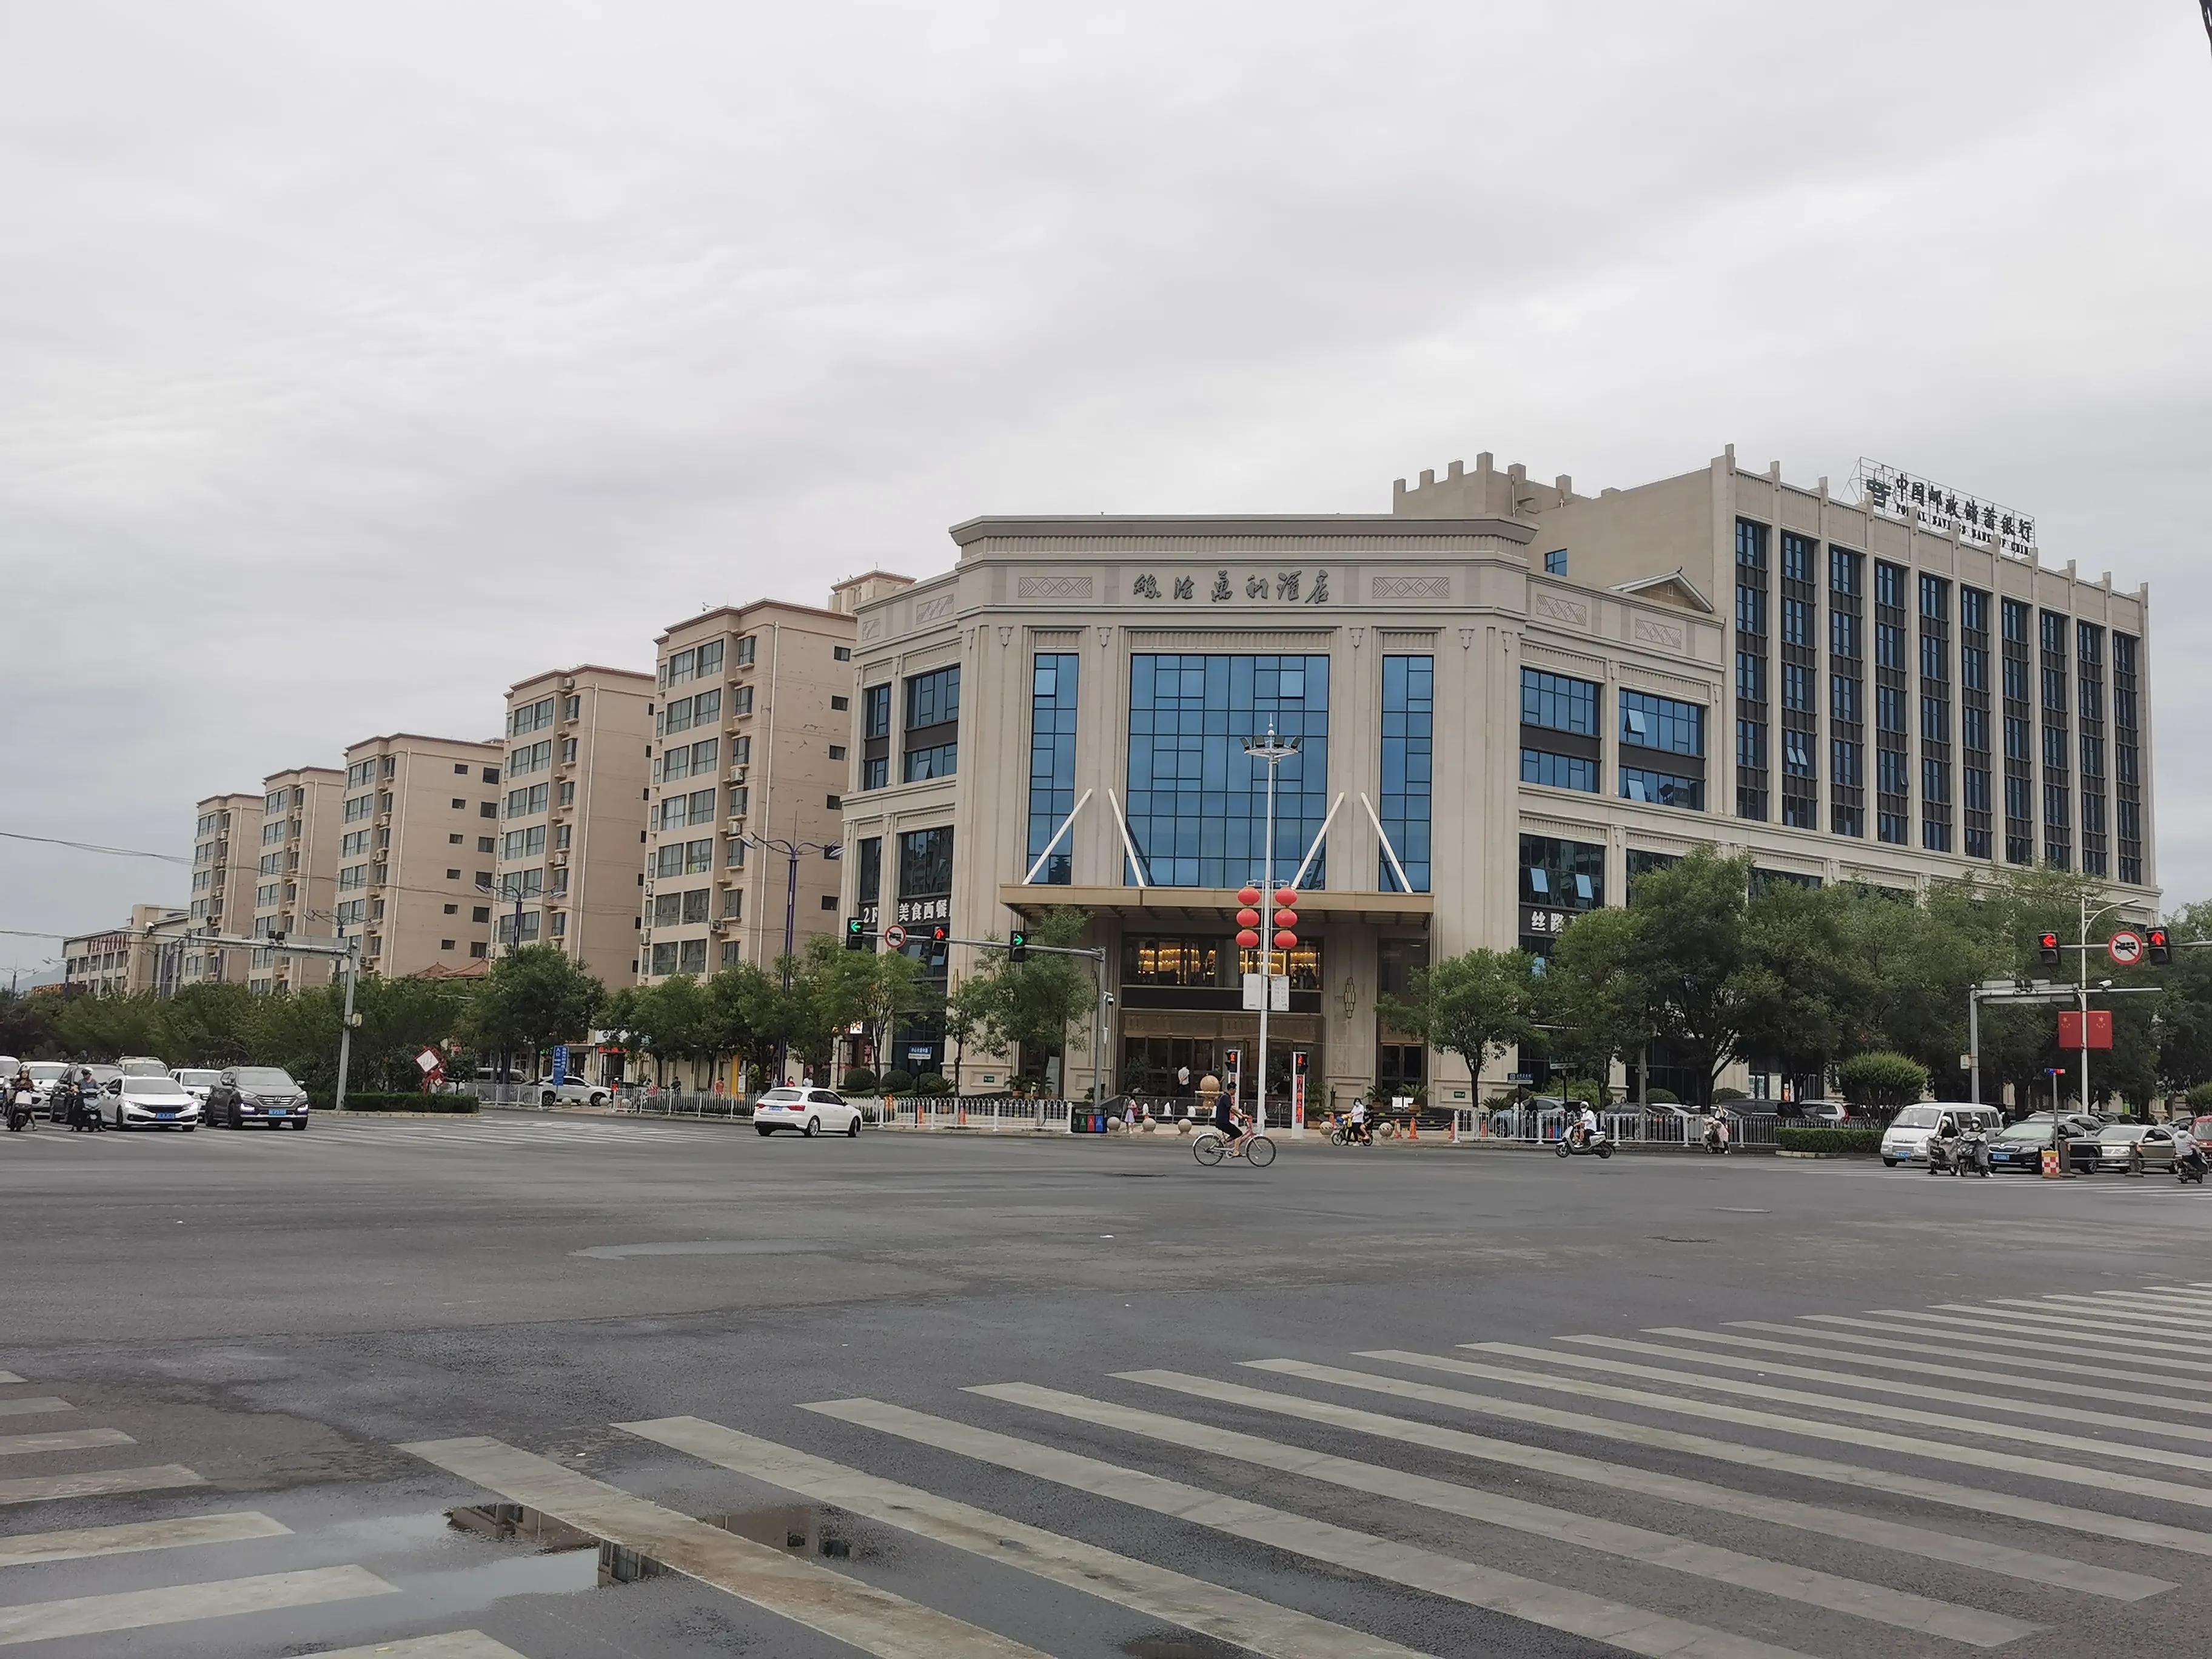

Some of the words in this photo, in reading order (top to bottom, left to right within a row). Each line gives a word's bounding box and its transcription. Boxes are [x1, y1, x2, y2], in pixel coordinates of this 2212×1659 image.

[1896, 473, 2032, 543] 中国邮政储蓄银行
[2011, 541, 2029, 555] CHIN
[863, 907, 879, 923] 2F
[898, 899, 951, 922] 美食西餐
[1531, 911, 1577, 932] 丝路
